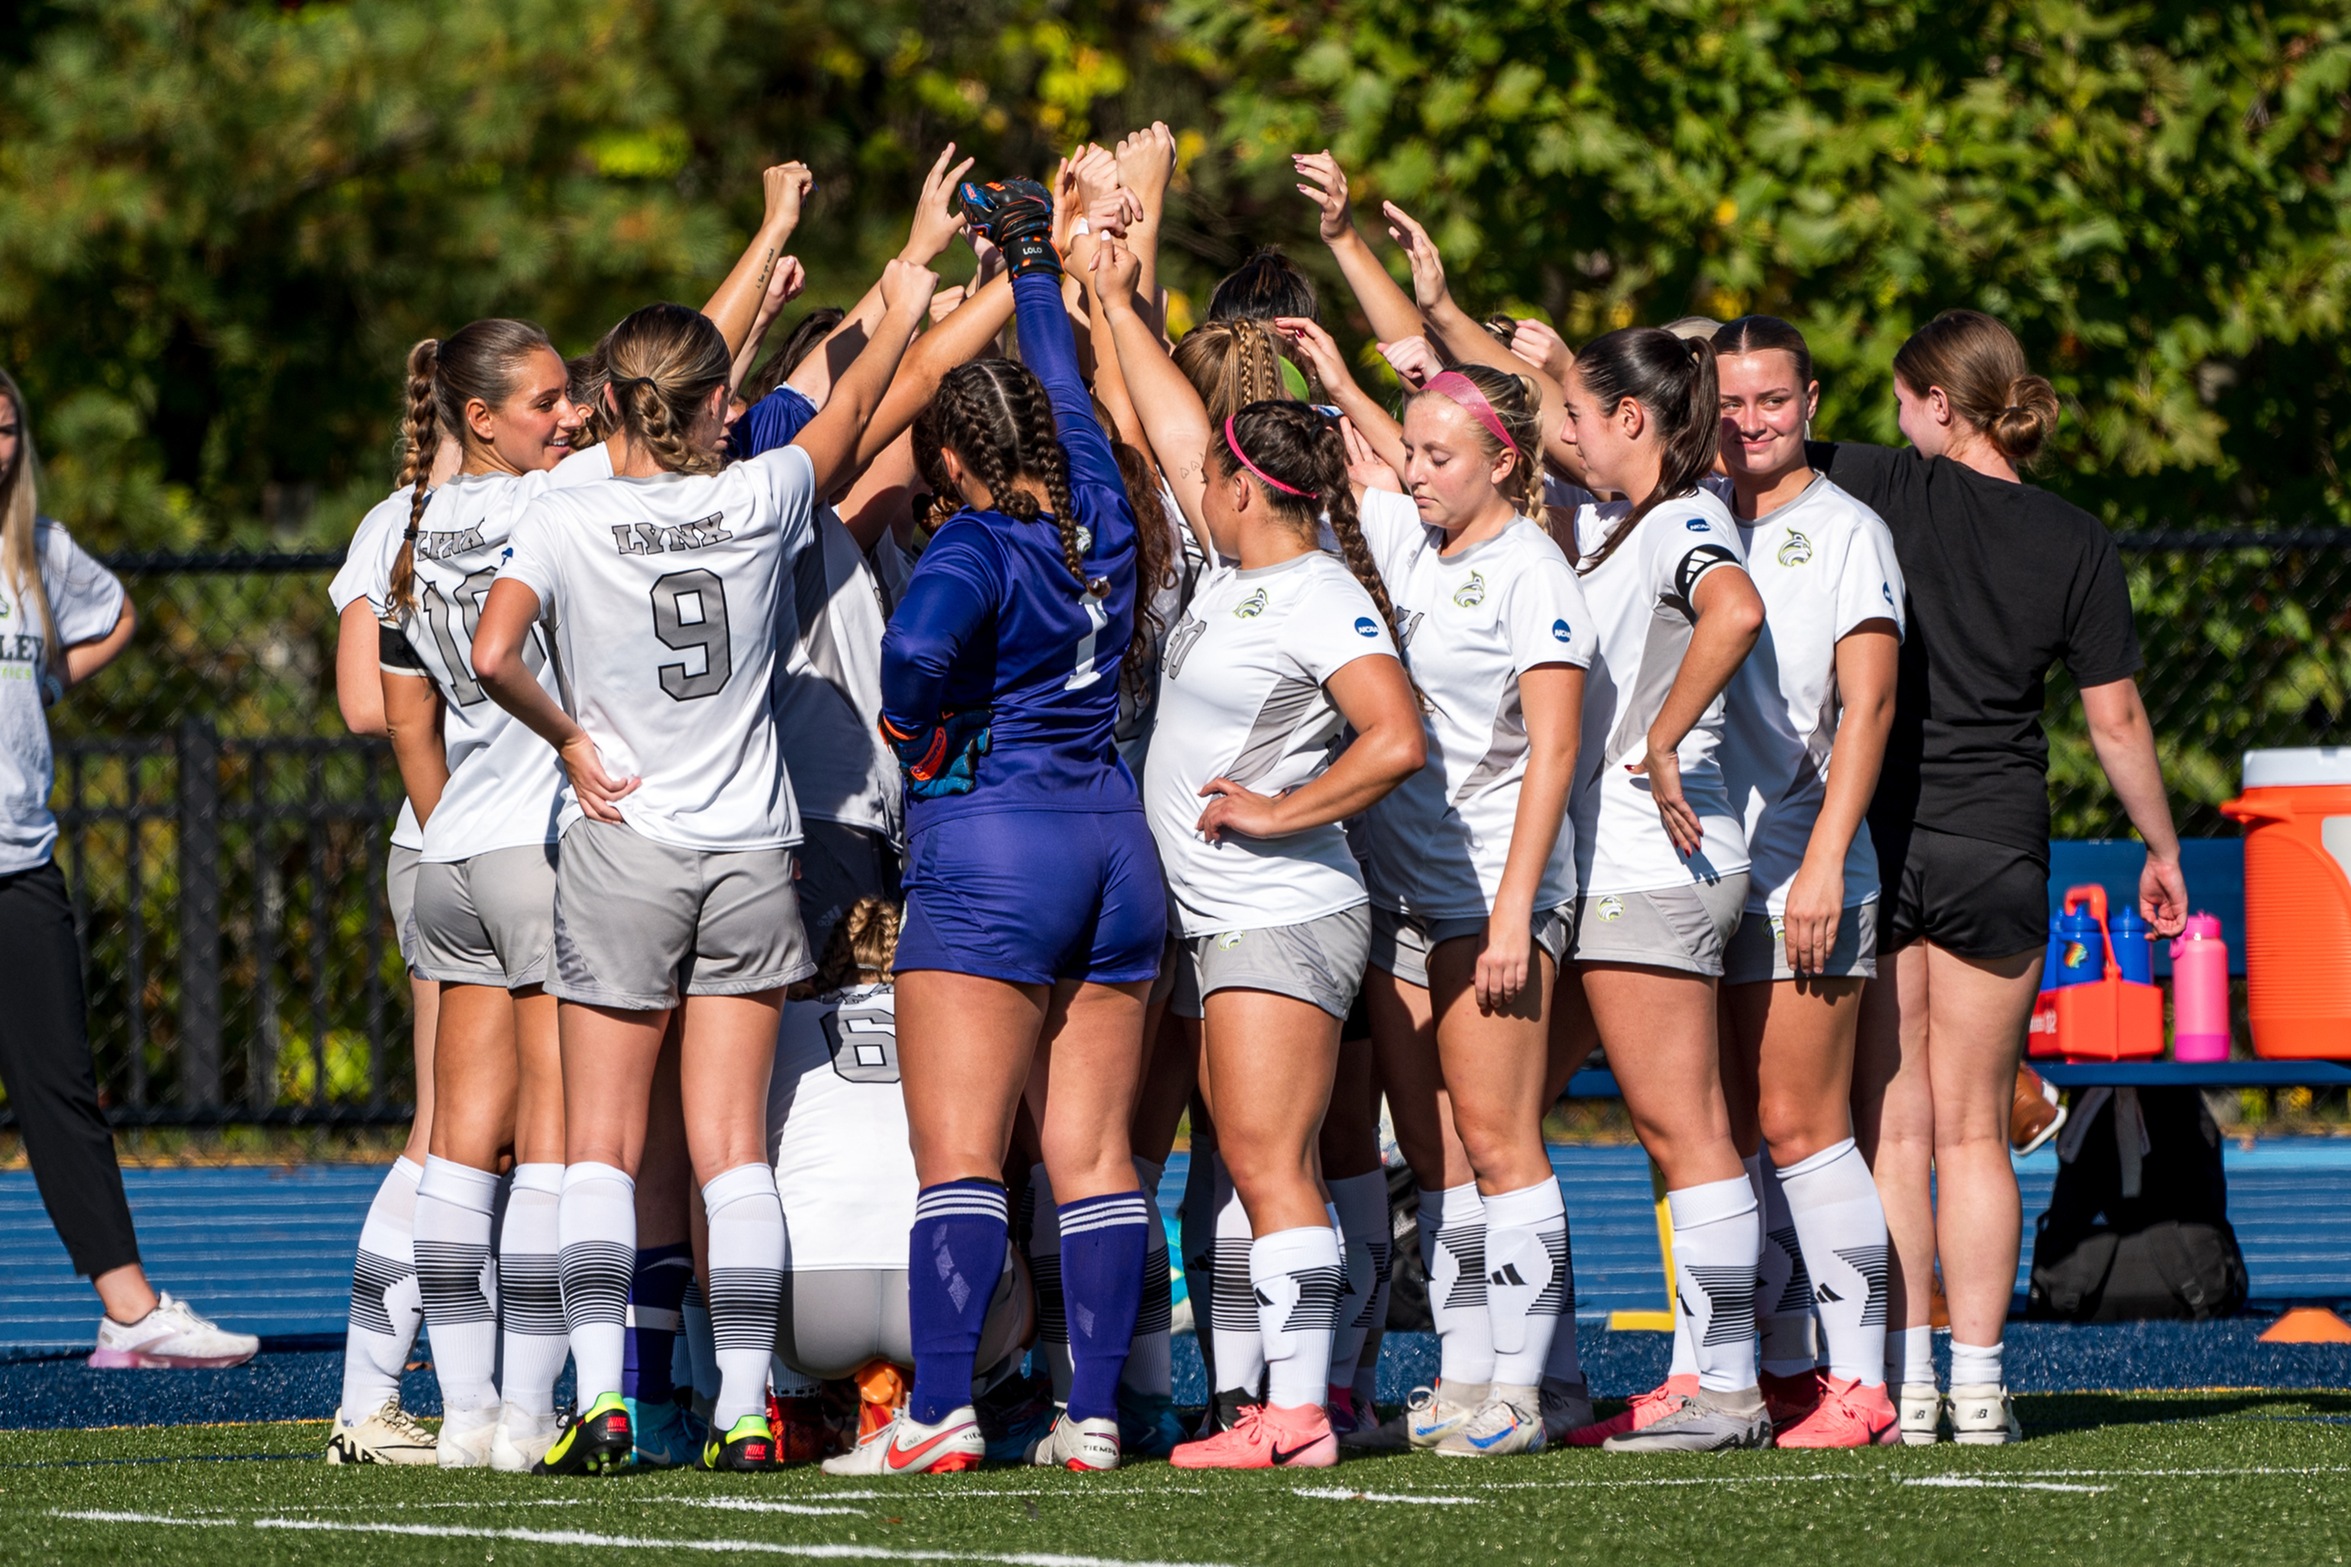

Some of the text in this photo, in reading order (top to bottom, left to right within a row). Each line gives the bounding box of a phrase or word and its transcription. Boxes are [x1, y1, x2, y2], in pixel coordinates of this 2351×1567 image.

[1022, 246, 1043, 255] LOLO
[611, 511, 733, 555] LYNX
[649, 567, 732, 702] 9
[1357, 625, 1379, 634] NCAA
[819, 1008, 901, 1084] 6
[607, 1416, 627, 1428] NIKE
[745, 1444, 767, 1456] NIKE
